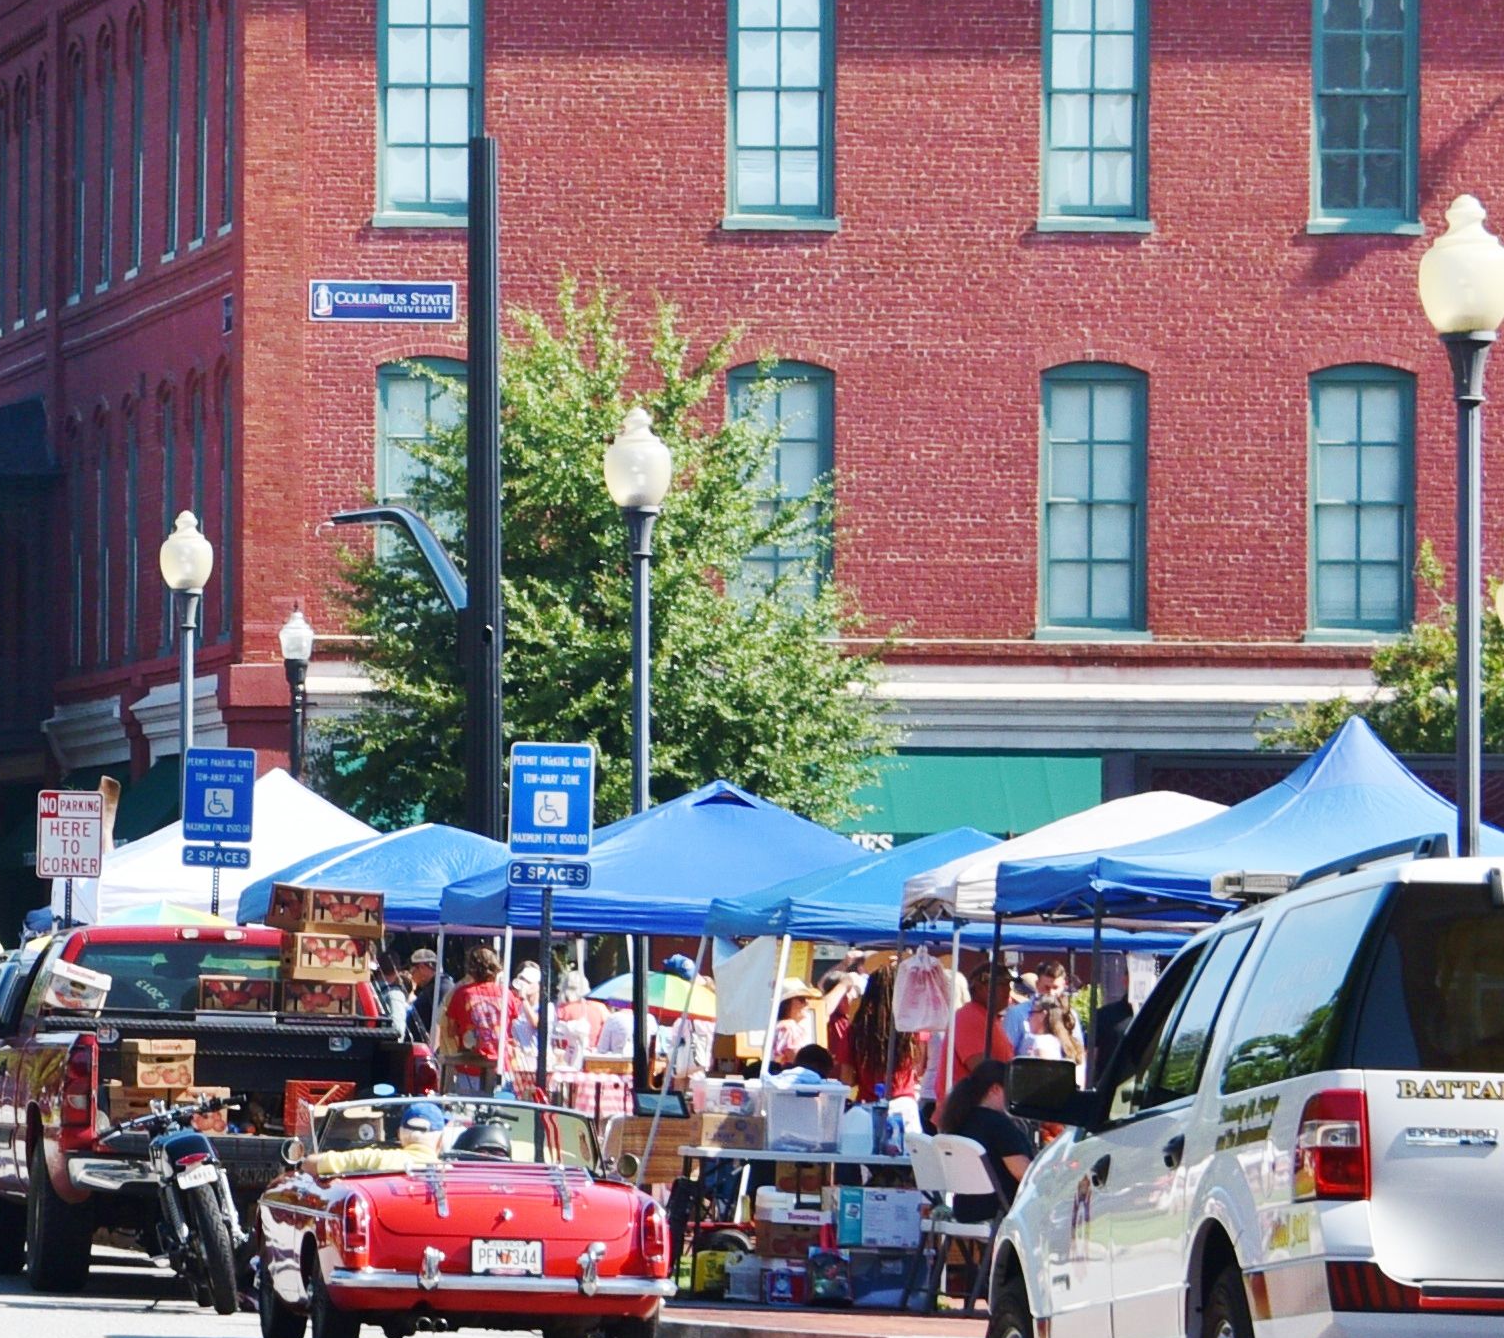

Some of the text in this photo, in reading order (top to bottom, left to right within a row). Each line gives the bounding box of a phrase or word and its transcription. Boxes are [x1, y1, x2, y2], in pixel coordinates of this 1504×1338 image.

[335, 292, 450, 305] COLUMBUS STATE
[187, 757, 252, 769] PERMIT PARKING ONLY
[513, 756, 590, 767] PERMIT PARKING ONLY
[195, 773, 244, 783] TOW-AWAY ZONE
[523, 773, 580, 785] TOW-AWAY ZONE
[41, 797, 99, 813] NO PARKING
[50, 821, 90, 837] HERE
[512, 833, 541, 843] MAXIMUM
[544, 834, 557, 844] FINE
[61, 840, 80, 855] TO
[186, 850, 247, 863] 2 SPACES
[42, 858, 97, 873] CORNER
[512, 866, 584, 881] 2 SPACES
[1406, 1127, 1497, 1139] EXPEDITION
